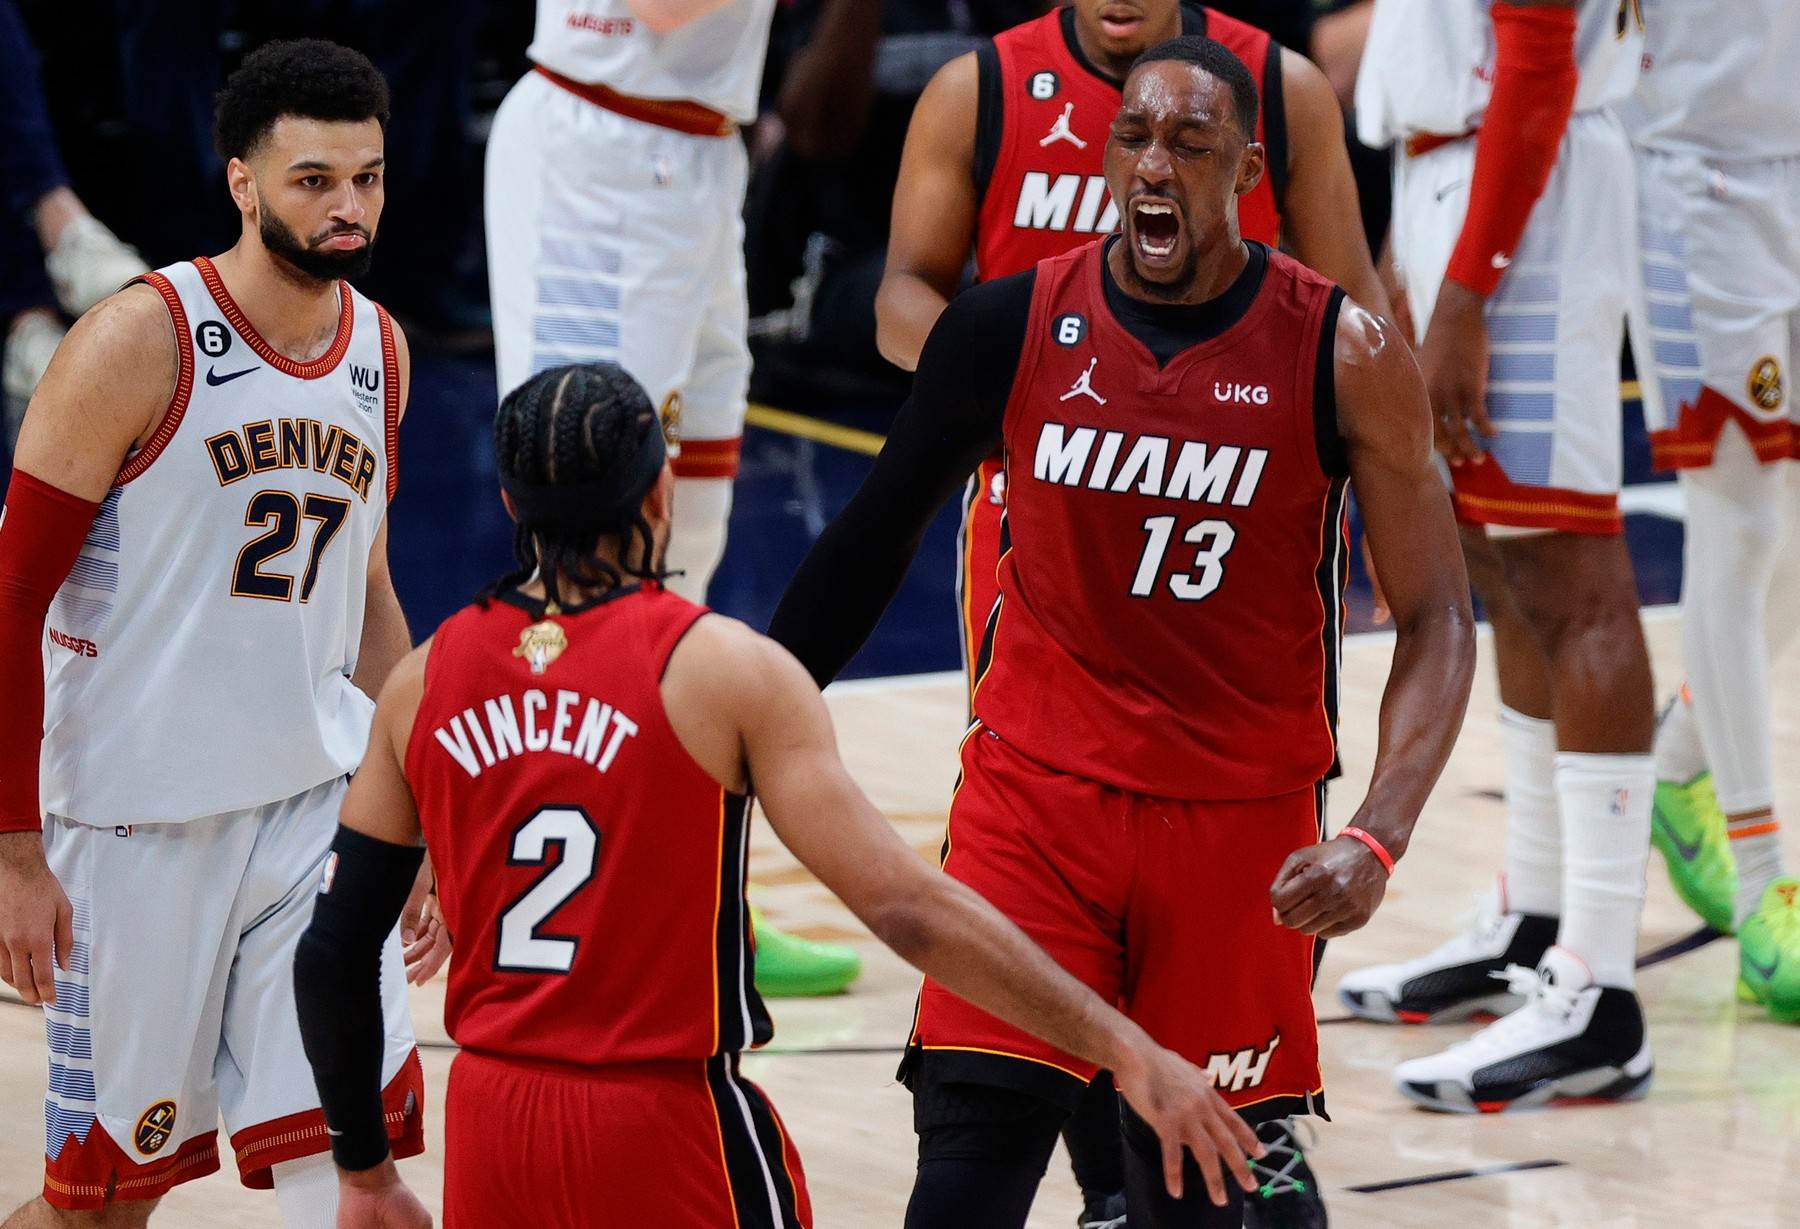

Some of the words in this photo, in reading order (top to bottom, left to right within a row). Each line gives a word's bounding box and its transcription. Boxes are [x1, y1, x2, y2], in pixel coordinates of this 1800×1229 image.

[1032, 72, 1055, 99] 6
[203, 326, 223, 353] 6
[1058, 317, 1081, 344] 6
[349, 363, 379, 391] WU
[1213, 382, 1270, 405] UKG
[204, 418, 376, 503] DENVER
[1032, 421, 1269, 507] MIAMI
[231, 489, 351, 603] 27
[1129, 515, 1237, 600] 13
[434, 688, 640, 779] VINCENT
[492, 803, 602, 976] 2
